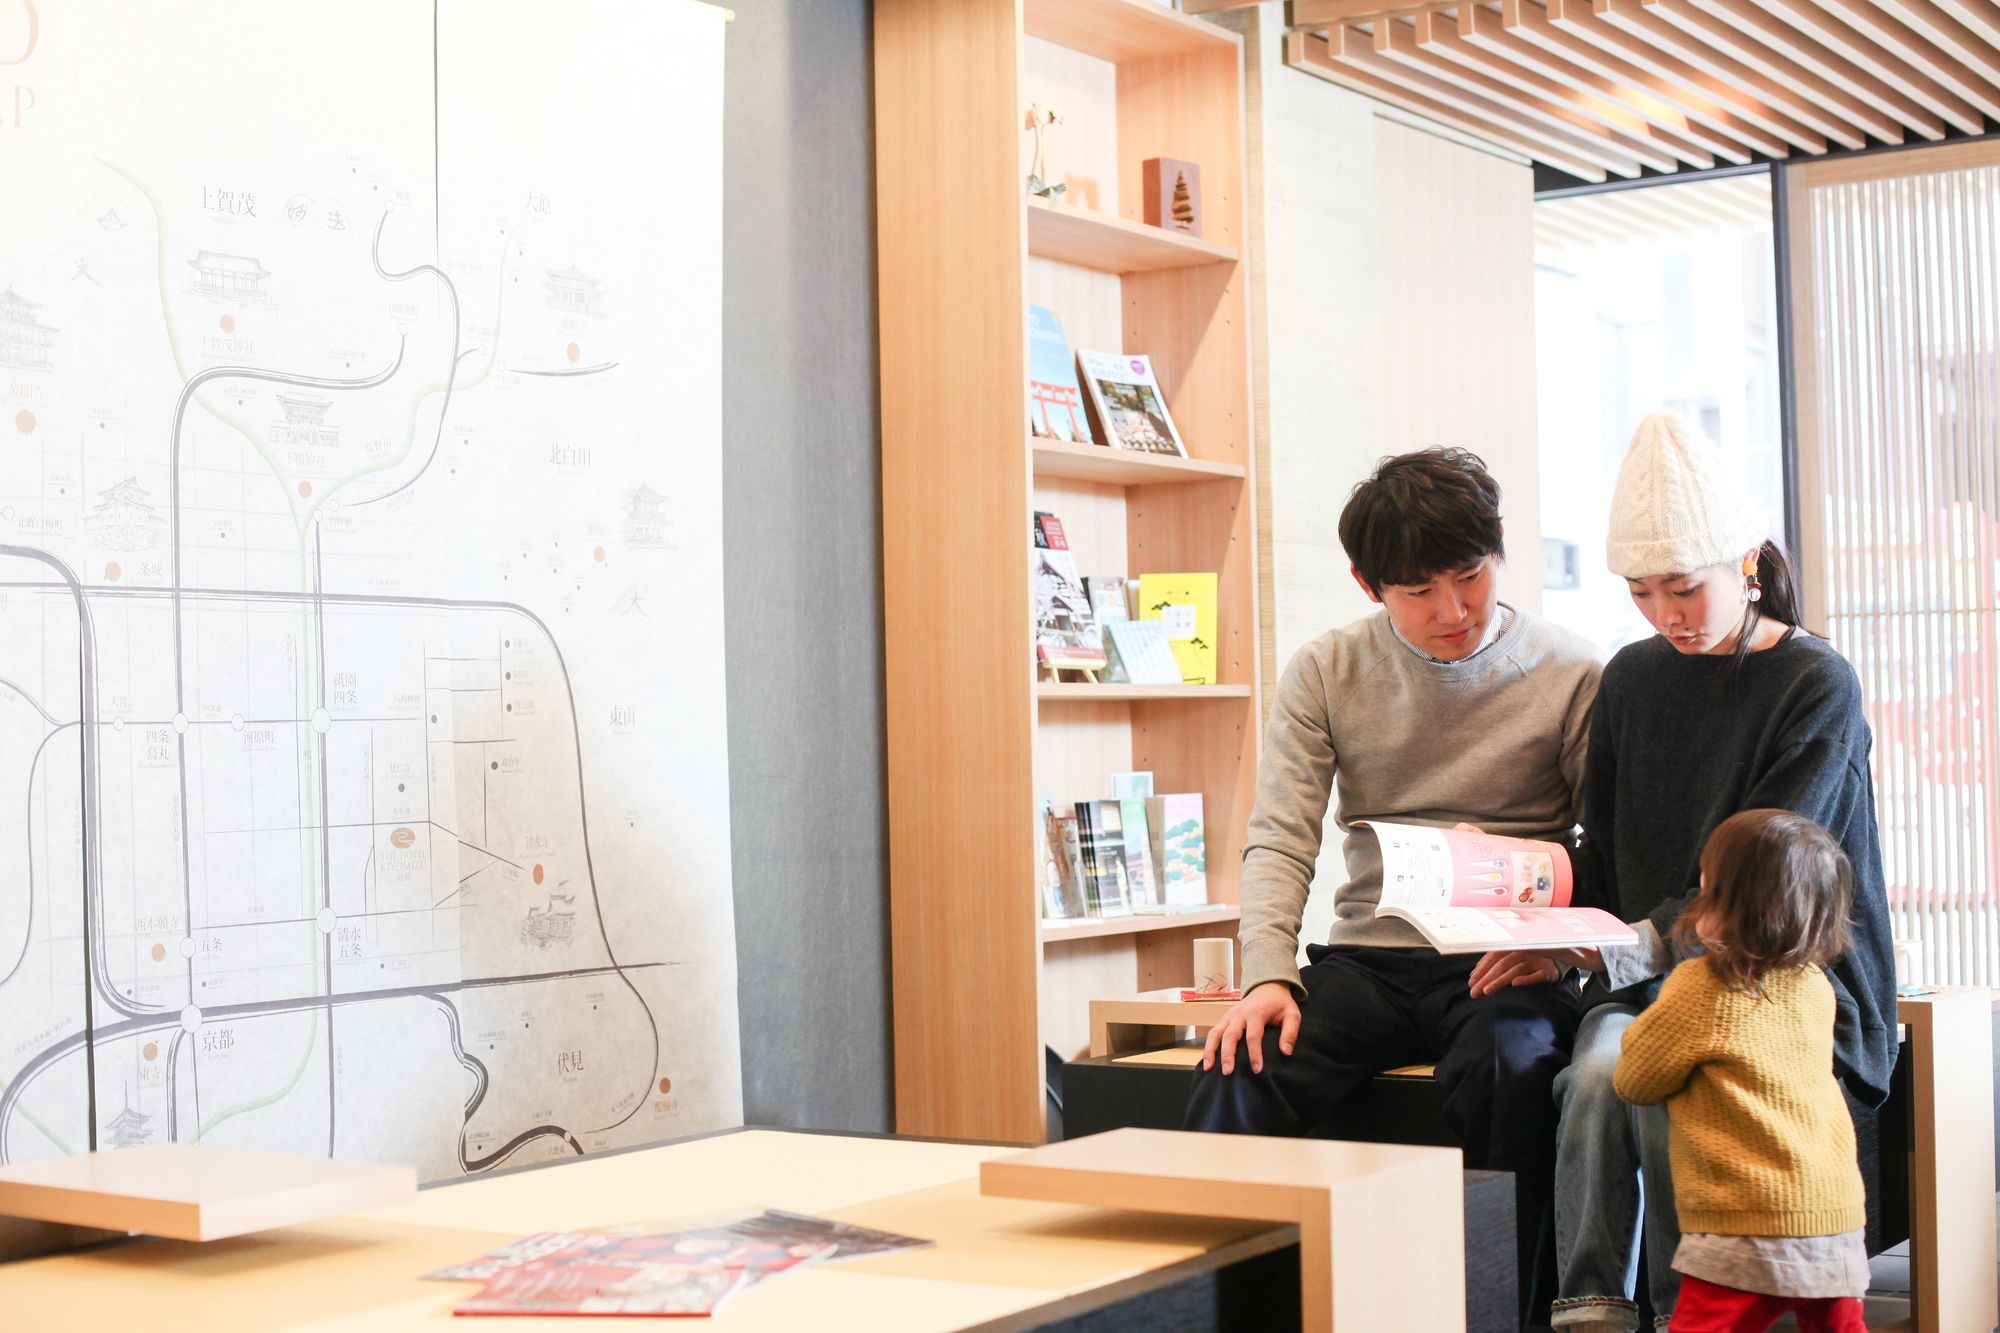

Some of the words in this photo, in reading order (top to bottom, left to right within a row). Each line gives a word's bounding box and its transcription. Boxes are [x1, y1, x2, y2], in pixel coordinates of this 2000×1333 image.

[199, 185, 257, 218] 上賀茂
[524, 189, 552, 215] 大原
[326, 209, 347, 231] 法
[548, 442, 591, 468] 北白川
[333, 690, 358, 705] 四条
[609, 705, 636, 728] 東山
[146, 729, 169, 745] 四条
[243, 729, 275, 745] 河原町
[380, 850, 399, 862] THE
[400, 849, 426, 861] HOTEL
[380, 860, 427, 873] KIYOMIZU
[337, 926, 362, 942] 清水
[201, 937, 223, 952] 五条
[339, 942, 362, 959] 五条
[203, 1028, 234, 1052] 京都
[557, 1049, 584, 1076] 伏見
